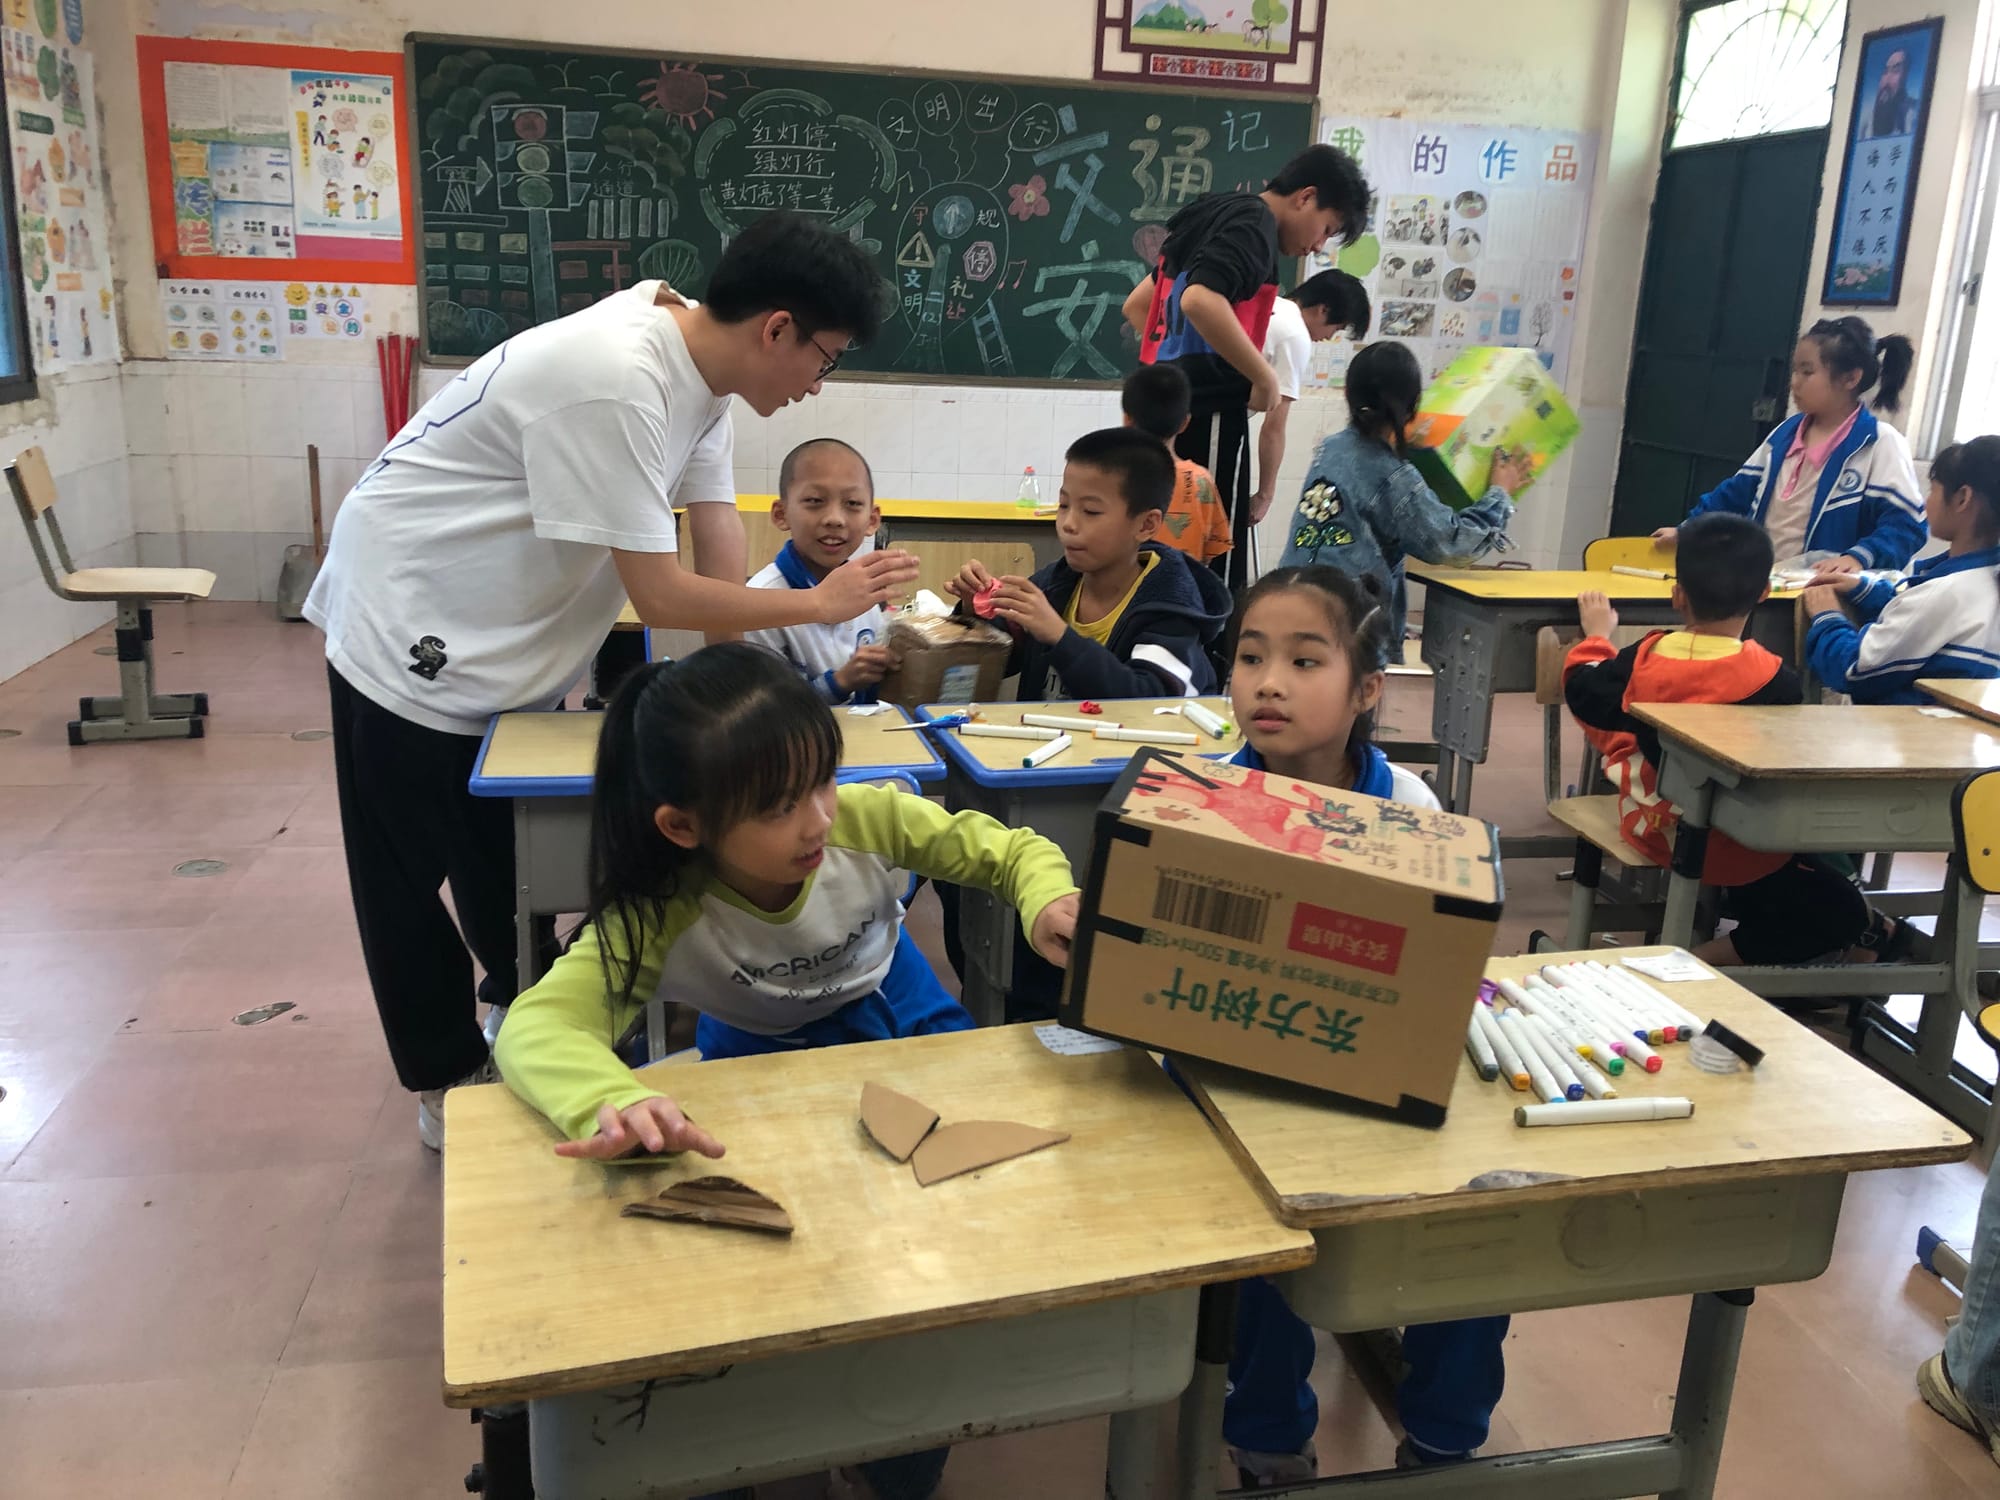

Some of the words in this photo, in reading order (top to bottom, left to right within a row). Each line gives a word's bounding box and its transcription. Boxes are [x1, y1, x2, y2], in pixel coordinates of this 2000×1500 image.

[1220, 110, 1270, 154] 记
[1331, 124, 1579, 182] 我的作品
[1031, 103, 1214, 244] 交通
[902, 268, 923, 316] 文明
[1022, 239, 1148, 379] 安
[1161, 966, 1366, 1054] 东方树叶
